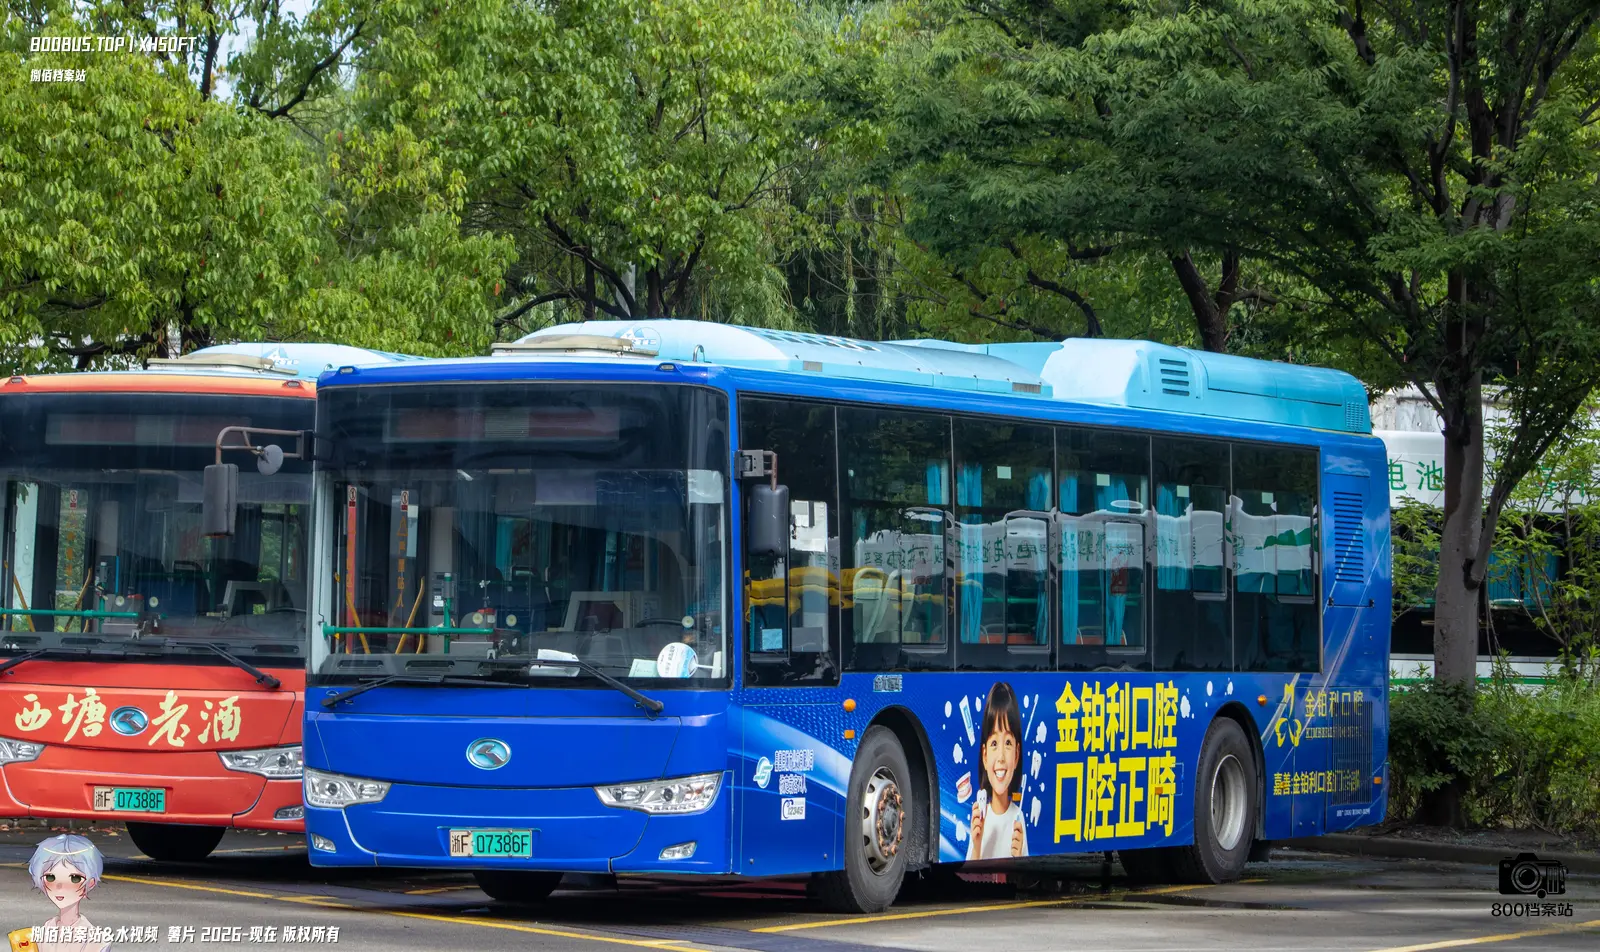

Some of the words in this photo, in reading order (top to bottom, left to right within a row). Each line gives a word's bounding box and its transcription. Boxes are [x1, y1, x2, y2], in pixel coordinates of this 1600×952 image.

[15, 688, 107, 742] 西塘
[148, 690, 241, 747] 老酒
[1055, 680, 1178, 753] 金铂利口腔
[1054, 751, 1177, 844] 口腔正畸
